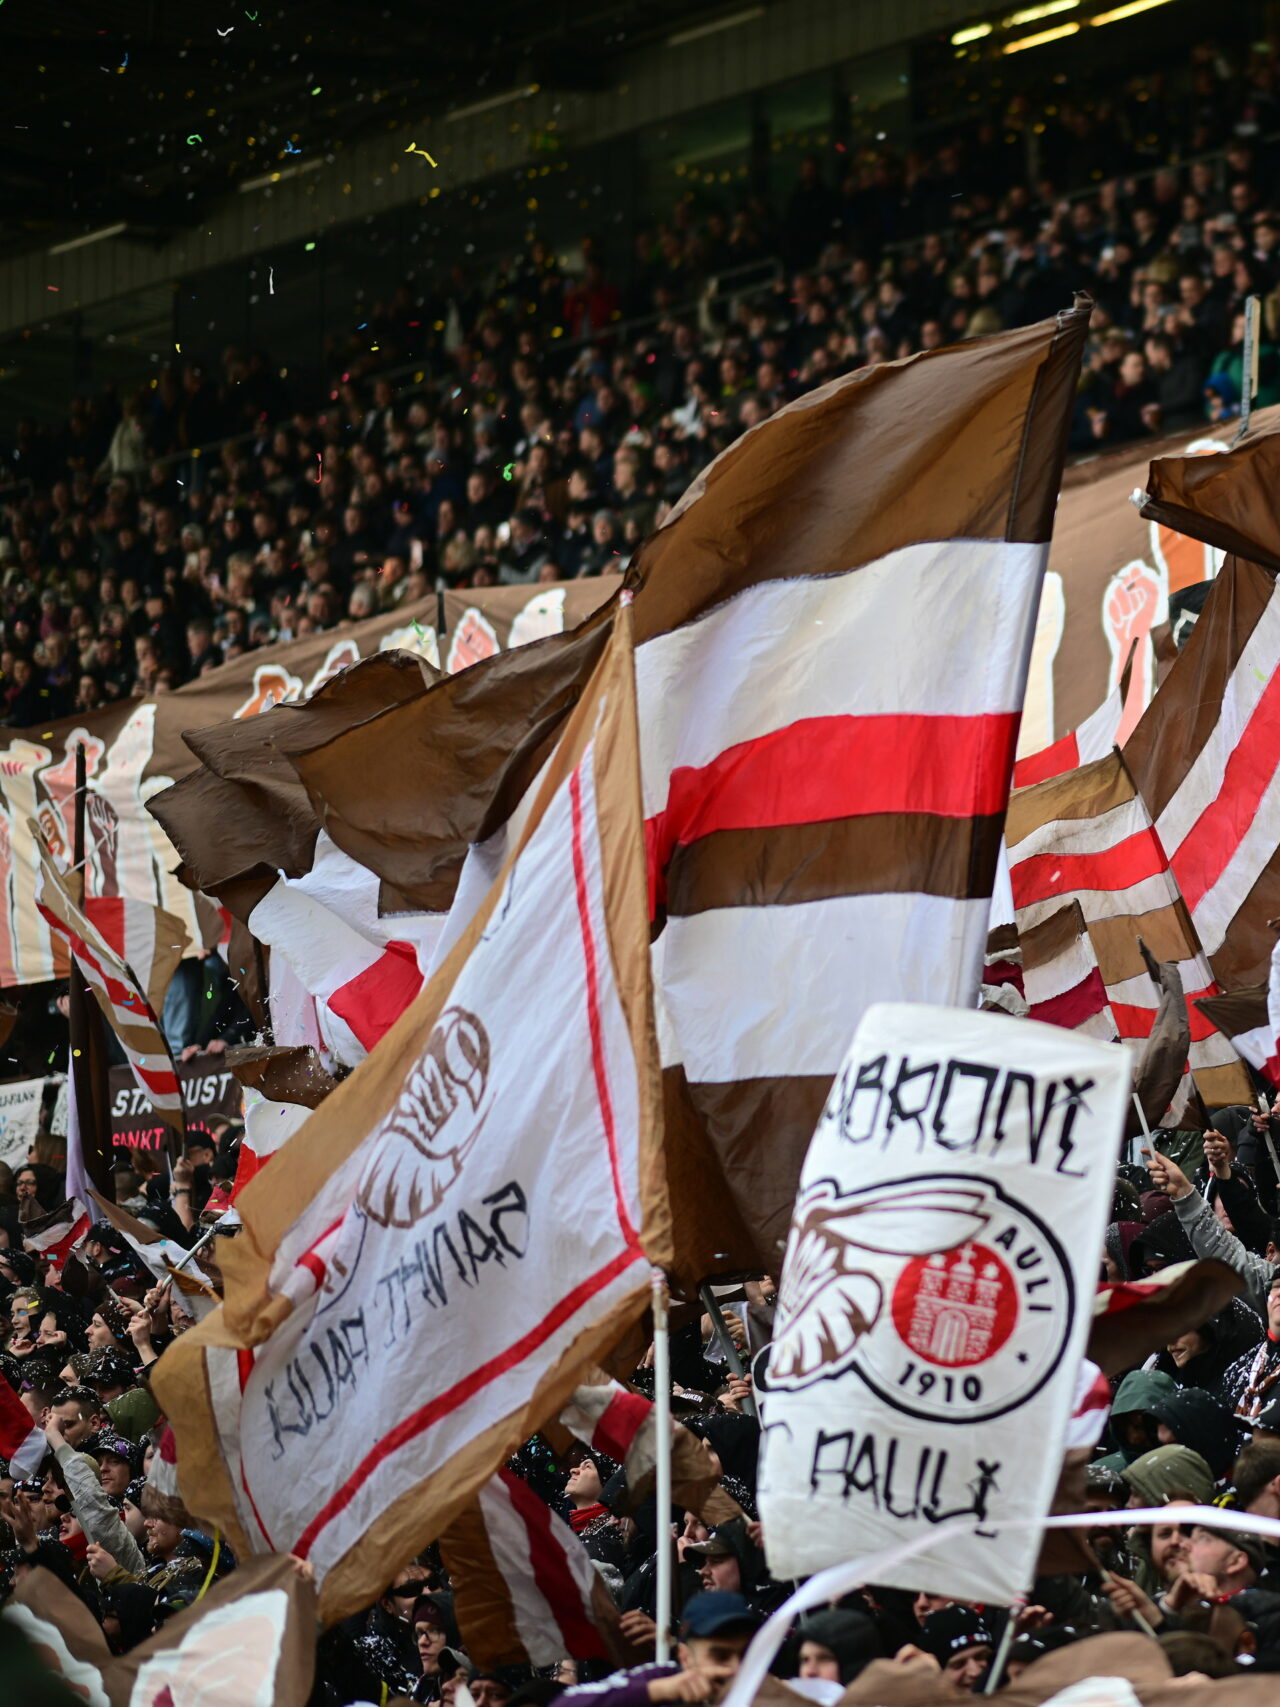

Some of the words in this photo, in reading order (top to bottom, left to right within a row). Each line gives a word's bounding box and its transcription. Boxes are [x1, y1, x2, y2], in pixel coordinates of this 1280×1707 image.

[111, 1072, 233, 1117] STAUST
[994, 1226, 1053, 1312] AULI
[898, 1362, 982, 1402] 1910
